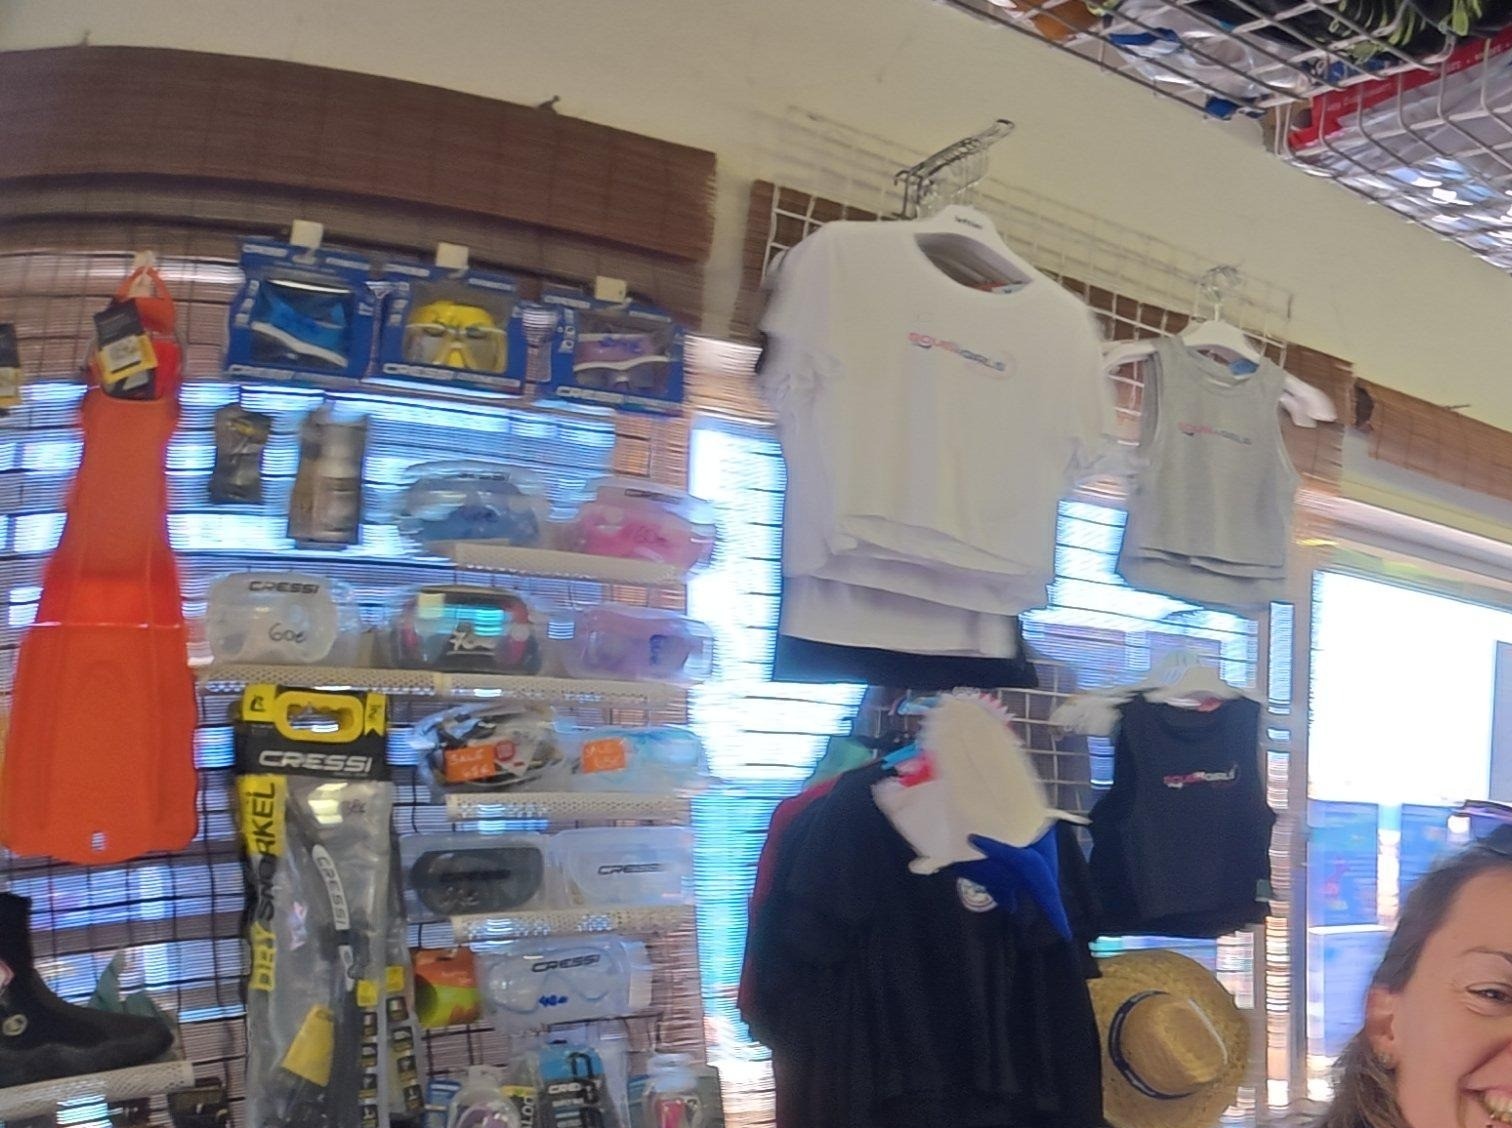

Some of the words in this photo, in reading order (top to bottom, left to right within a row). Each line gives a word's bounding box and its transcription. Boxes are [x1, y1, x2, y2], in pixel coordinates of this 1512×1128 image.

[249, 581, 320, 594] CRESSI
[259, 750, 373, 773] CRESSI
[532, 953, 600, 973] CRESSI
